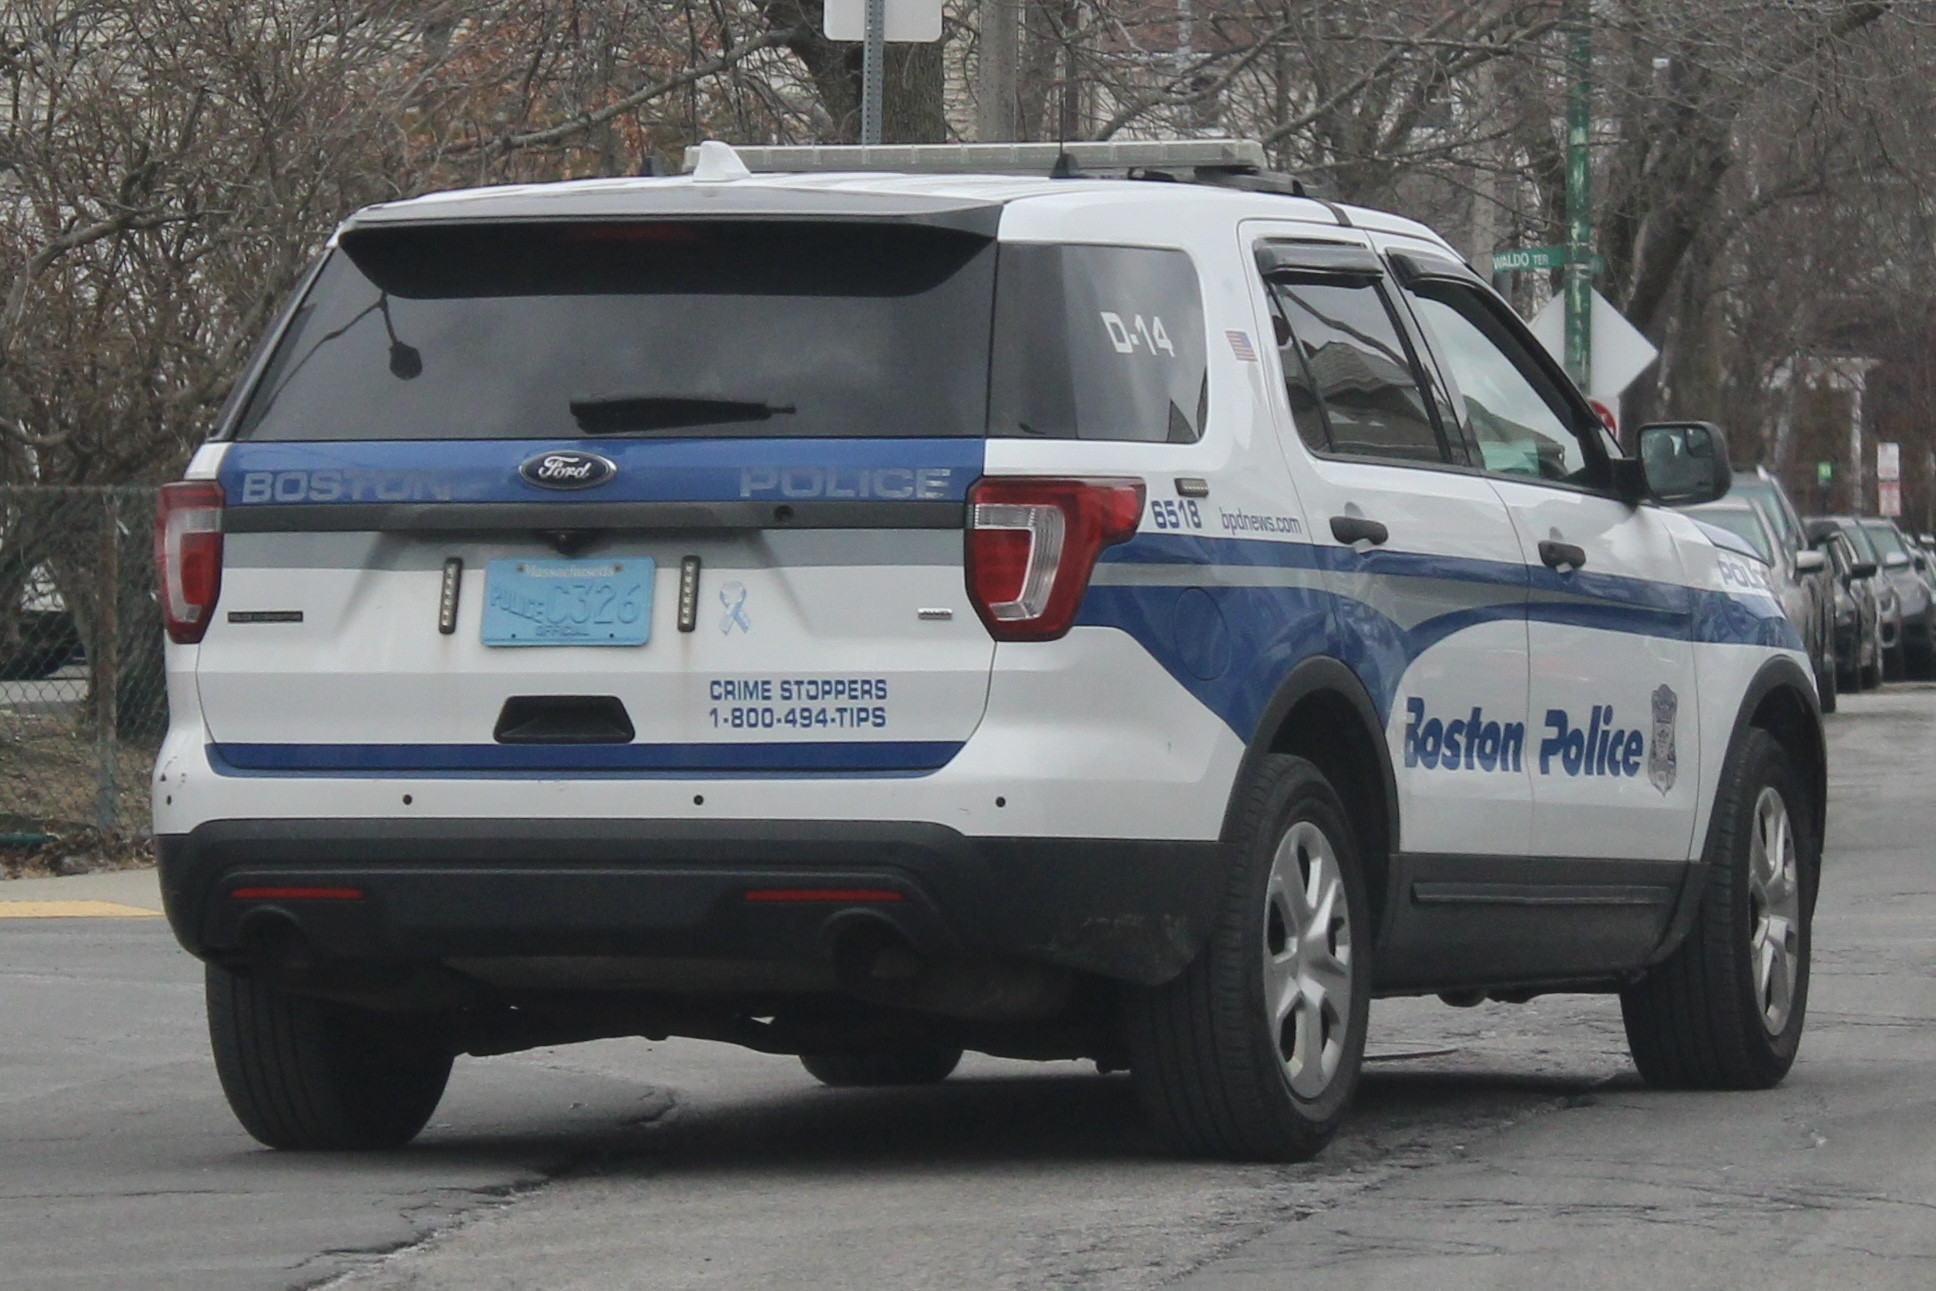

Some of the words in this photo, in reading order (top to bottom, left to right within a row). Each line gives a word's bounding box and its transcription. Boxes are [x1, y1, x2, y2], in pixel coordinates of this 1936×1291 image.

[1493, 252, 1529, 270] WALDO
[1533, 254, 1549, 266] TER
[1100, 311, 1176, 358] D-14
[537, 456, 590, 479] Ford
[242, 470, 451, 502] BOSTON
[739, 467, 951, 499] POLICE
[1151, 500, 1202, 530] 6518
[1218, 506, 1302, 537] bpdnews.com
[709, 679, 773, 701] CRIME
[780, 678, 887, 701] STOPPERS
[709, 706, 887, 729] 1-800-494-TIPS
[1404, 696, 1525, 773] Boston
[1539, 704, 1644, 778] Police
